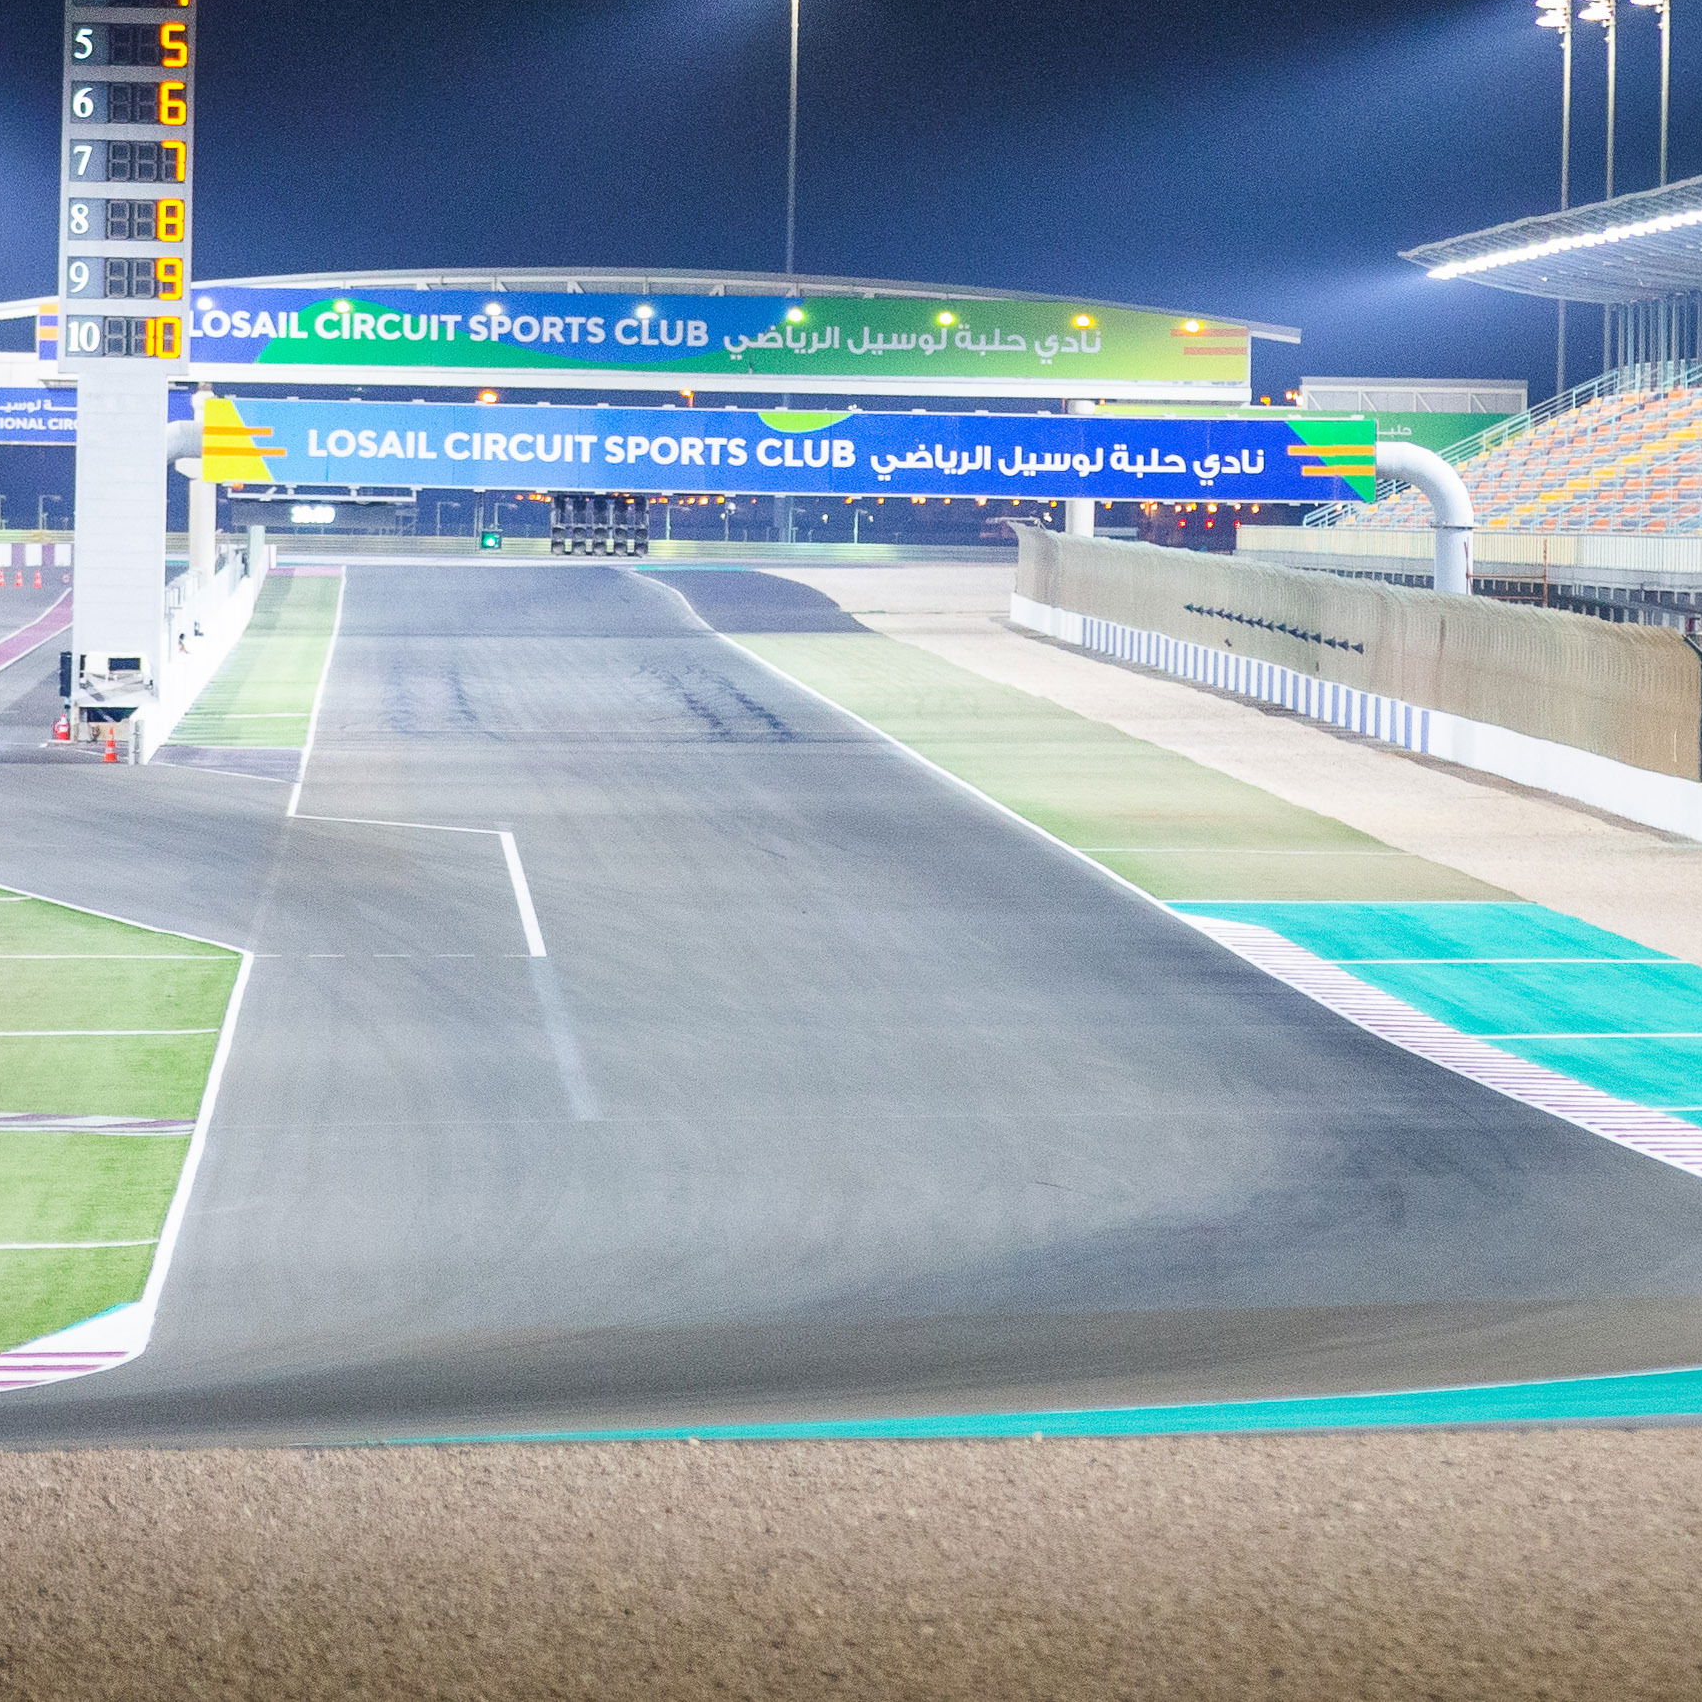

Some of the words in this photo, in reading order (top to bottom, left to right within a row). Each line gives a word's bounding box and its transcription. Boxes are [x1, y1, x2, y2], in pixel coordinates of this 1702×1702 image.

[73, 28, 94, 60] 5
[159, 21, 189, 68] 5
[72, 86, 95, 118] 6
[158, 80, 187, 126] 6
[73, 145, 93, 177] 7
[161, 138, 187, 183] 7
[70, 203, 90, 235] 8
[156, 197, 185, 243] 8
[69, 261, 89, 294] 9
[156, 256, 184, 301] 9
[67, 320, 101, 353] 10
[144, 315, 183, 360] 10
[188, 310, 308, 339] LOSAIL
[314, 312, 463, 341] CIRCUIT
[469, 314, 606, 344] SPORTS
[614, 318, 709, 347] CLUB
[722, 324, 841, 361] الرياضي
[845, 326, 948, 356] لوسيل
[954, 323, 1027, 356] حلبة
[1033, 329, 1102, 365] نادي
[307, 429, 438, 459] LOSAIL
[443, 432, 598, 463] CIRCUIT
[604, 435, 748, 466] SPORTS
[755, 438, 857, 468] CLUB
[869, 443, 992, 481] الرياضي
[998, 446, 1104, 478] لوسيل
[1109, 443, 1187, 479] حلبة
[1192, 448, 1266, 487] نادي
